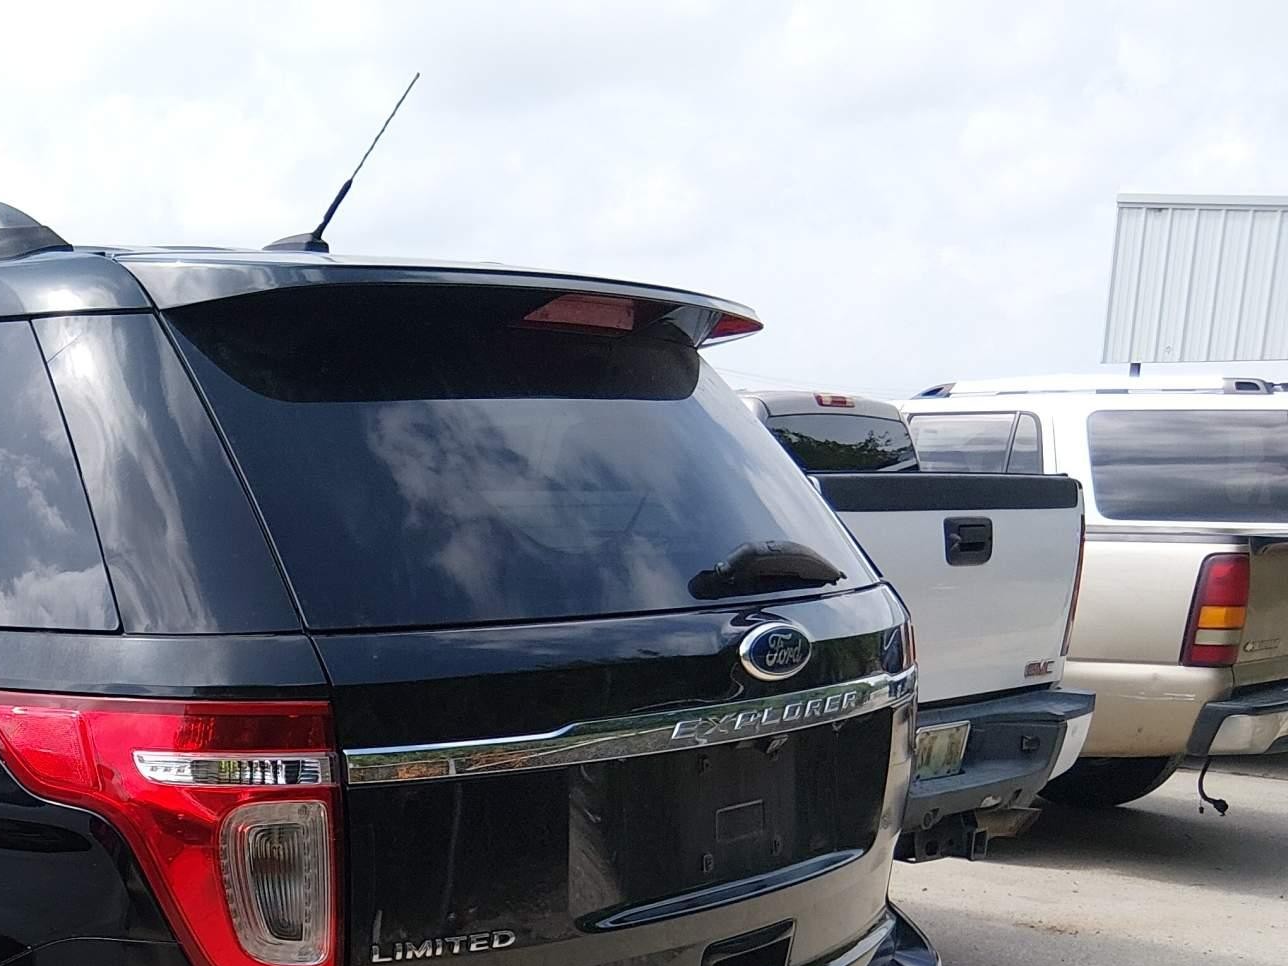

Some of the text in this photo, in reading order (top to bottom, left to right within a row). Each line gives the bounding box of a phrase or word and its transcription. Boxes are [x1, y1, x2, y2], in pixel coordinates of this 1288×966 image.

[765, 633, 802, 667] Ford
[671, 690, 858, 740] EXPLORER
[372, 929, 517, 963] LIMITED
